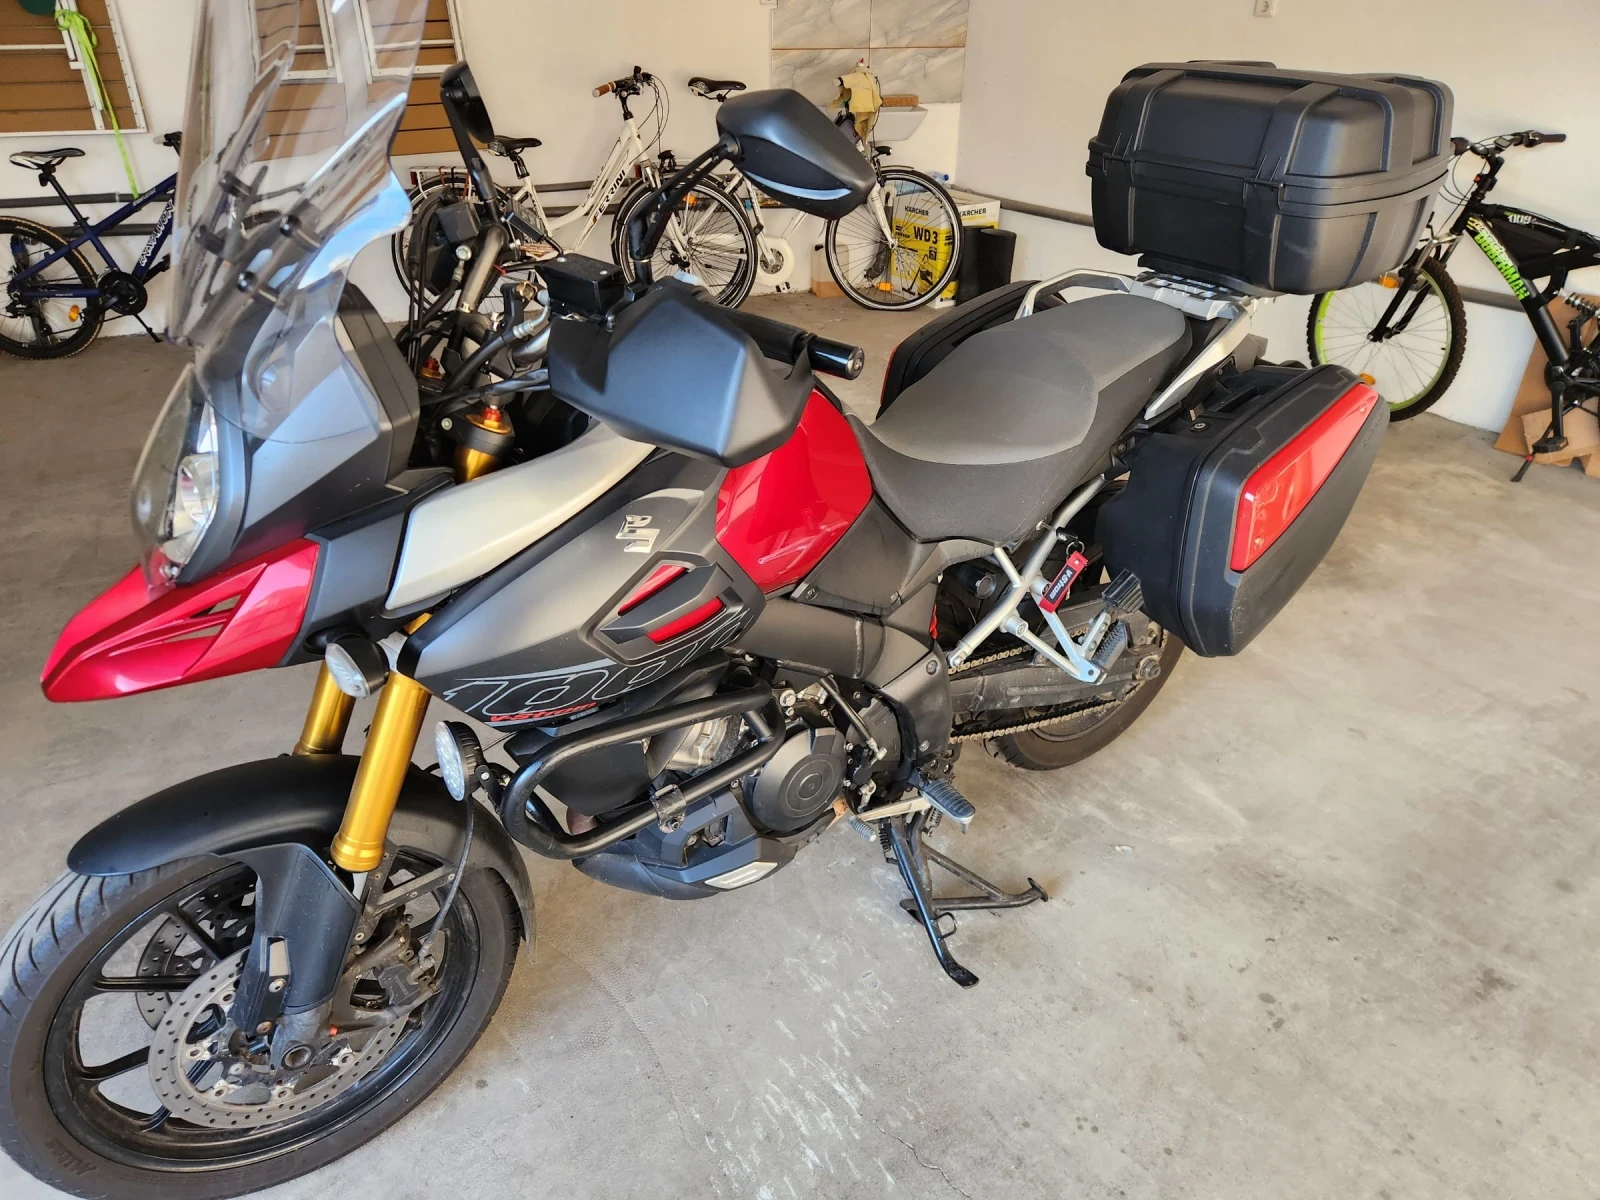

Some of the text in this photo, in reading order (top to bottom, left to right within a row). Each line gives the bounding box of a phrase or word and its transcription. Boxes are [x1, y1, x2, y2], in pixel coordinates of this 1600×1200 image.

[593, 169, 626, 223] FERRINI
[914, 226, 930, 242] WD
[931, 231, 938, 244] 3
[1474, 232, 1530, 301] DOBERMAN
[1049, 569, 1073, 600] V-Strom
